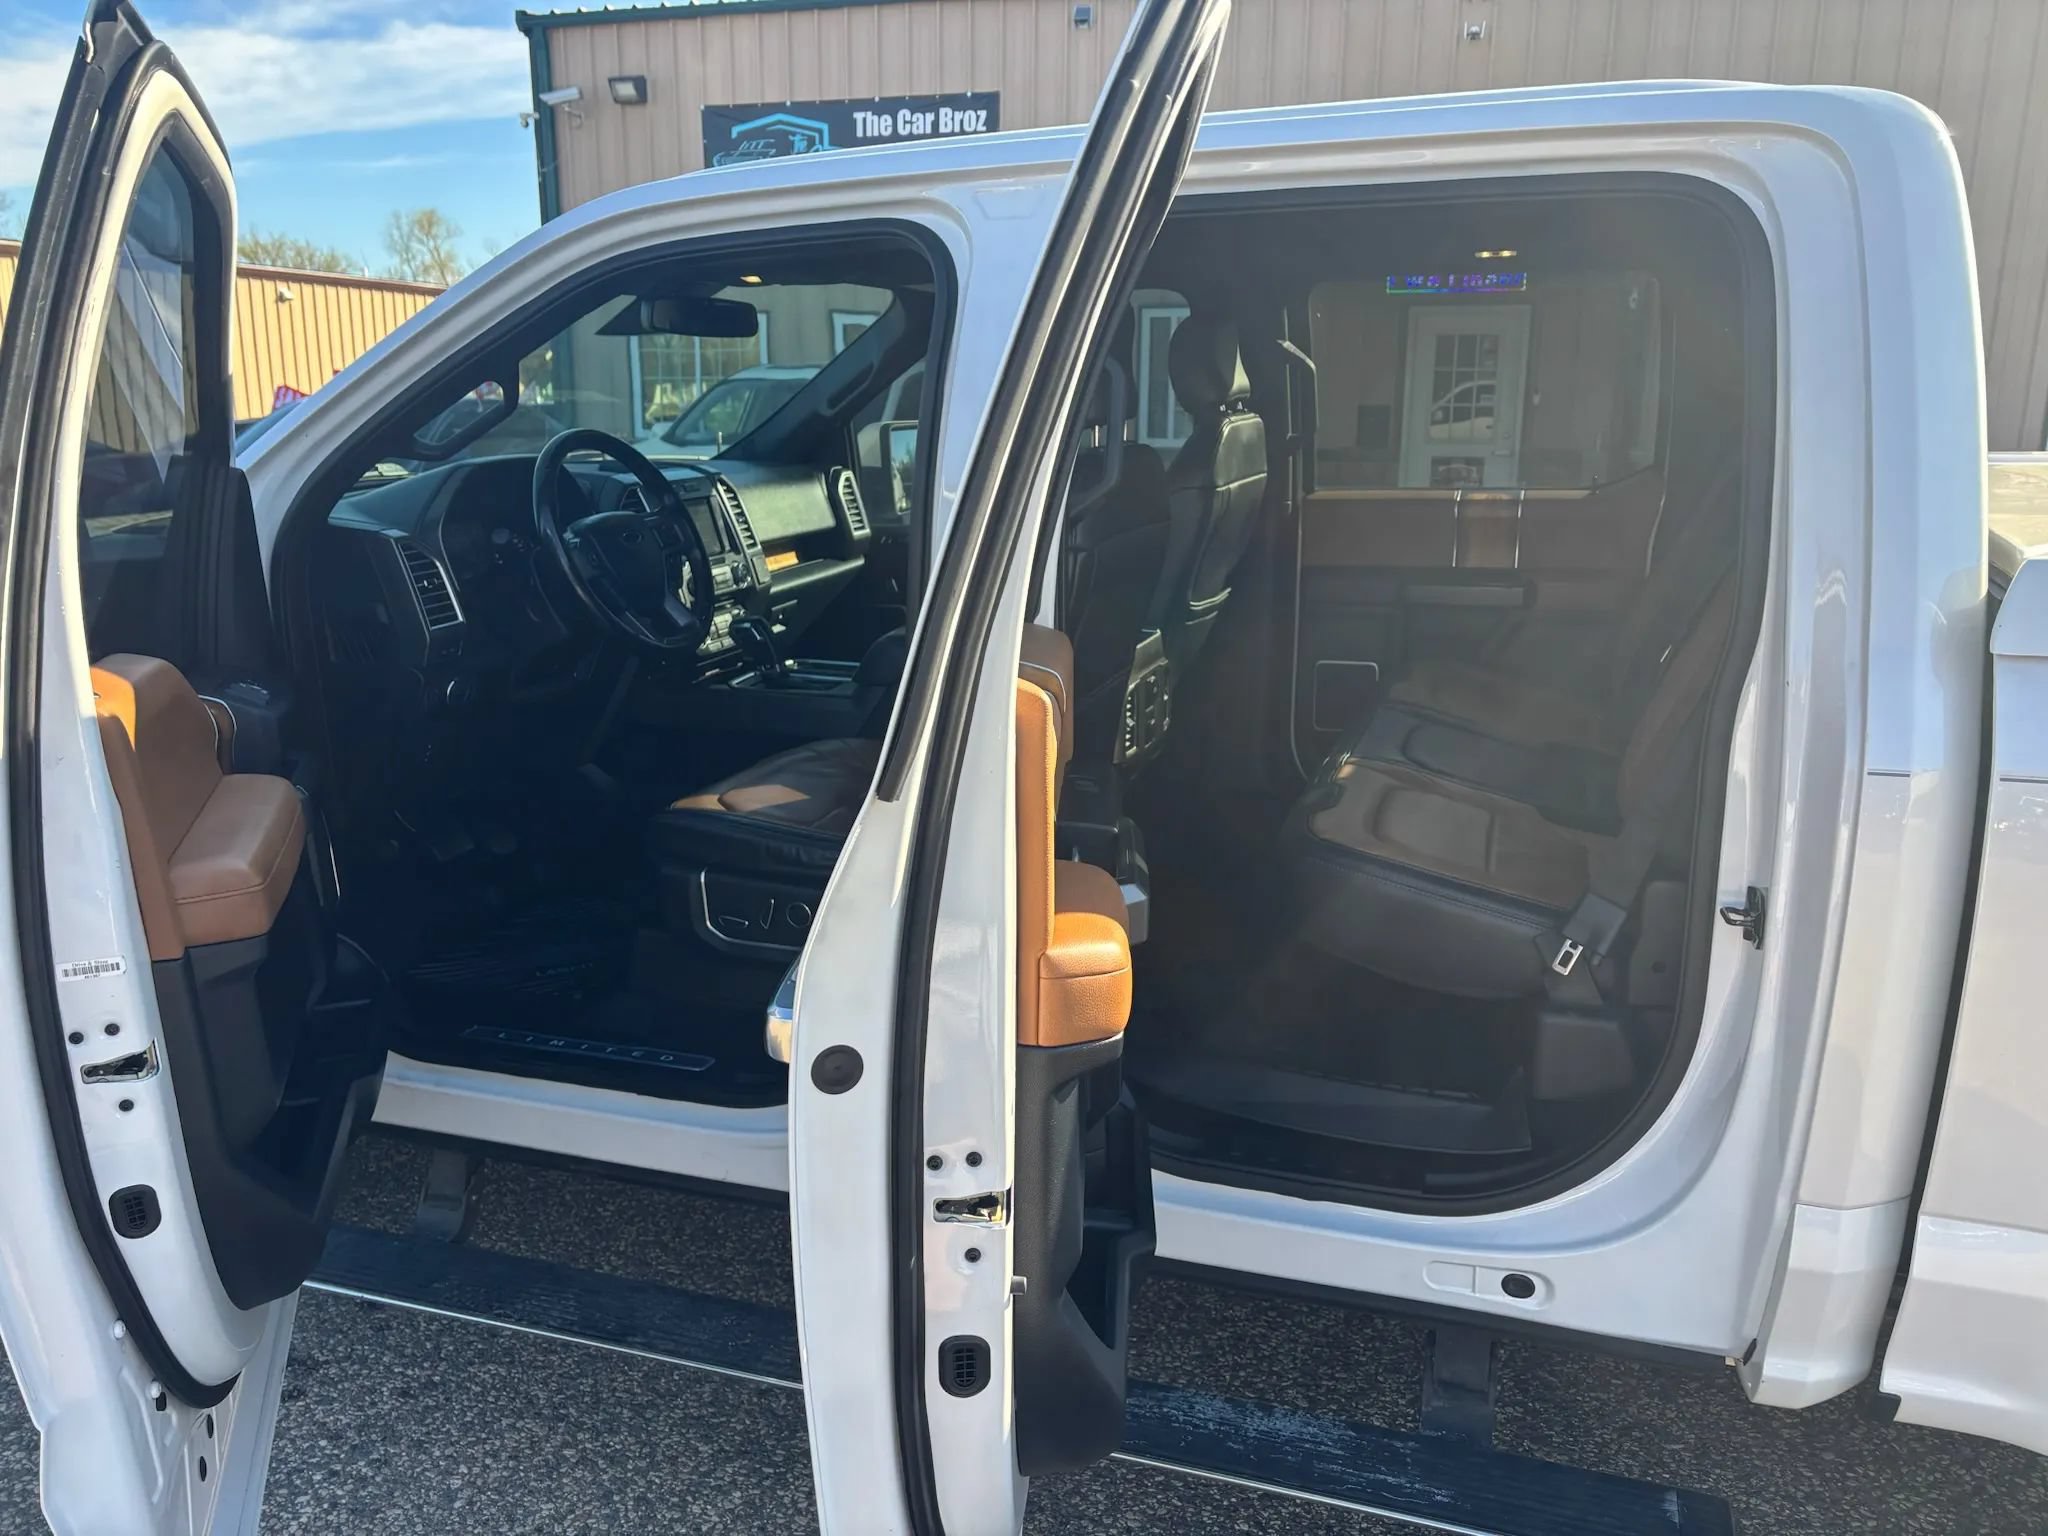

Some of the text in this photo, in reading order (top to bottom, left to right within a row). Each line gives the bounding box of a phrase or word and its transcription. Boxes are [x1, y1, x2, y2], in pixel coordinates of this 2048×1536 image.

[853, 107, 988, 138] The Car Broz
[498, 1032, 674, 1062] LIMITED
